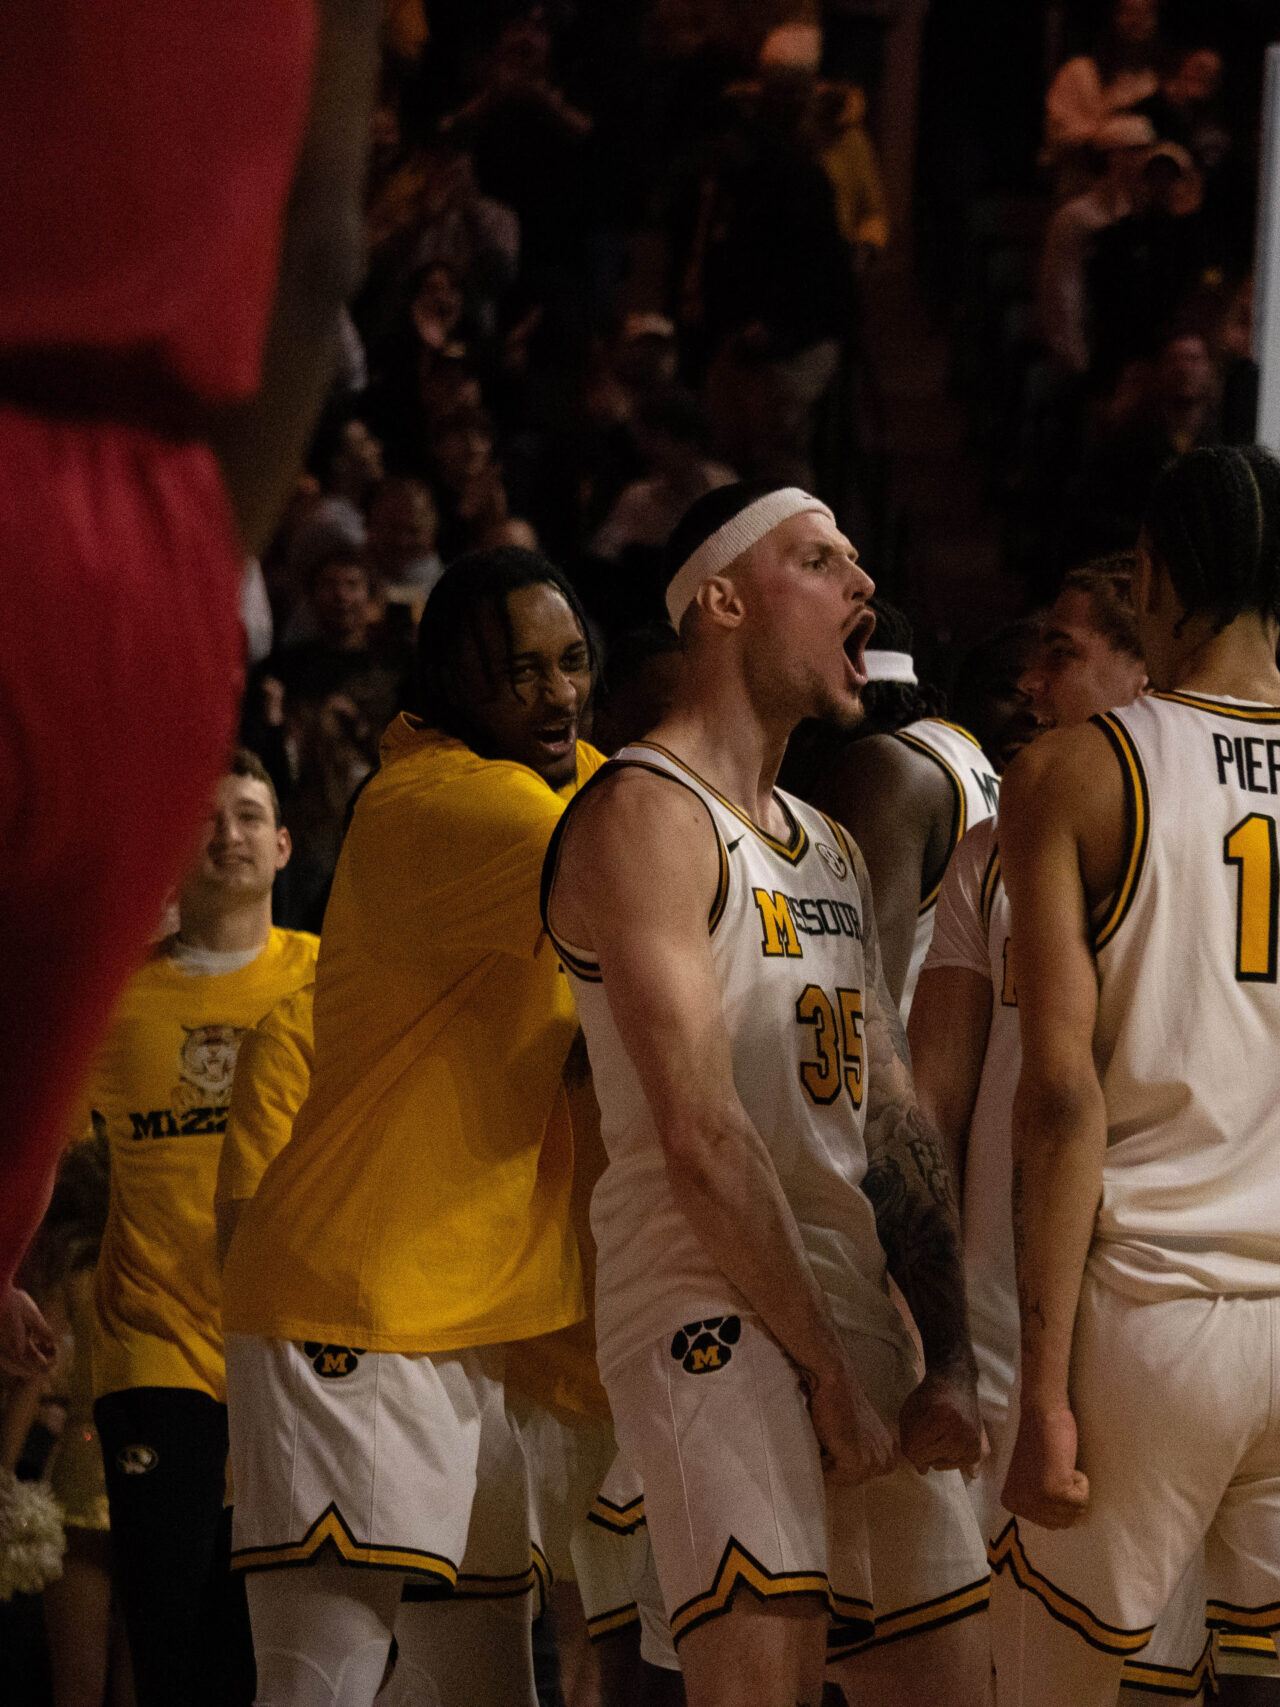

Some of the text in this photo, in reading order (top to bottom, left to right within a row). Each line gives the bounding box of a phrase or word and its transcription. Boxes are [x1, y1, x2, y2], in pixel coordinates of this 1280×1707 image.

[751, 887, 860, 958] MSSOUR
[796, 984, 864, 1110] 35
[321, 1352, 348, 1374] M
[692, 1345, 721, 1370] M
